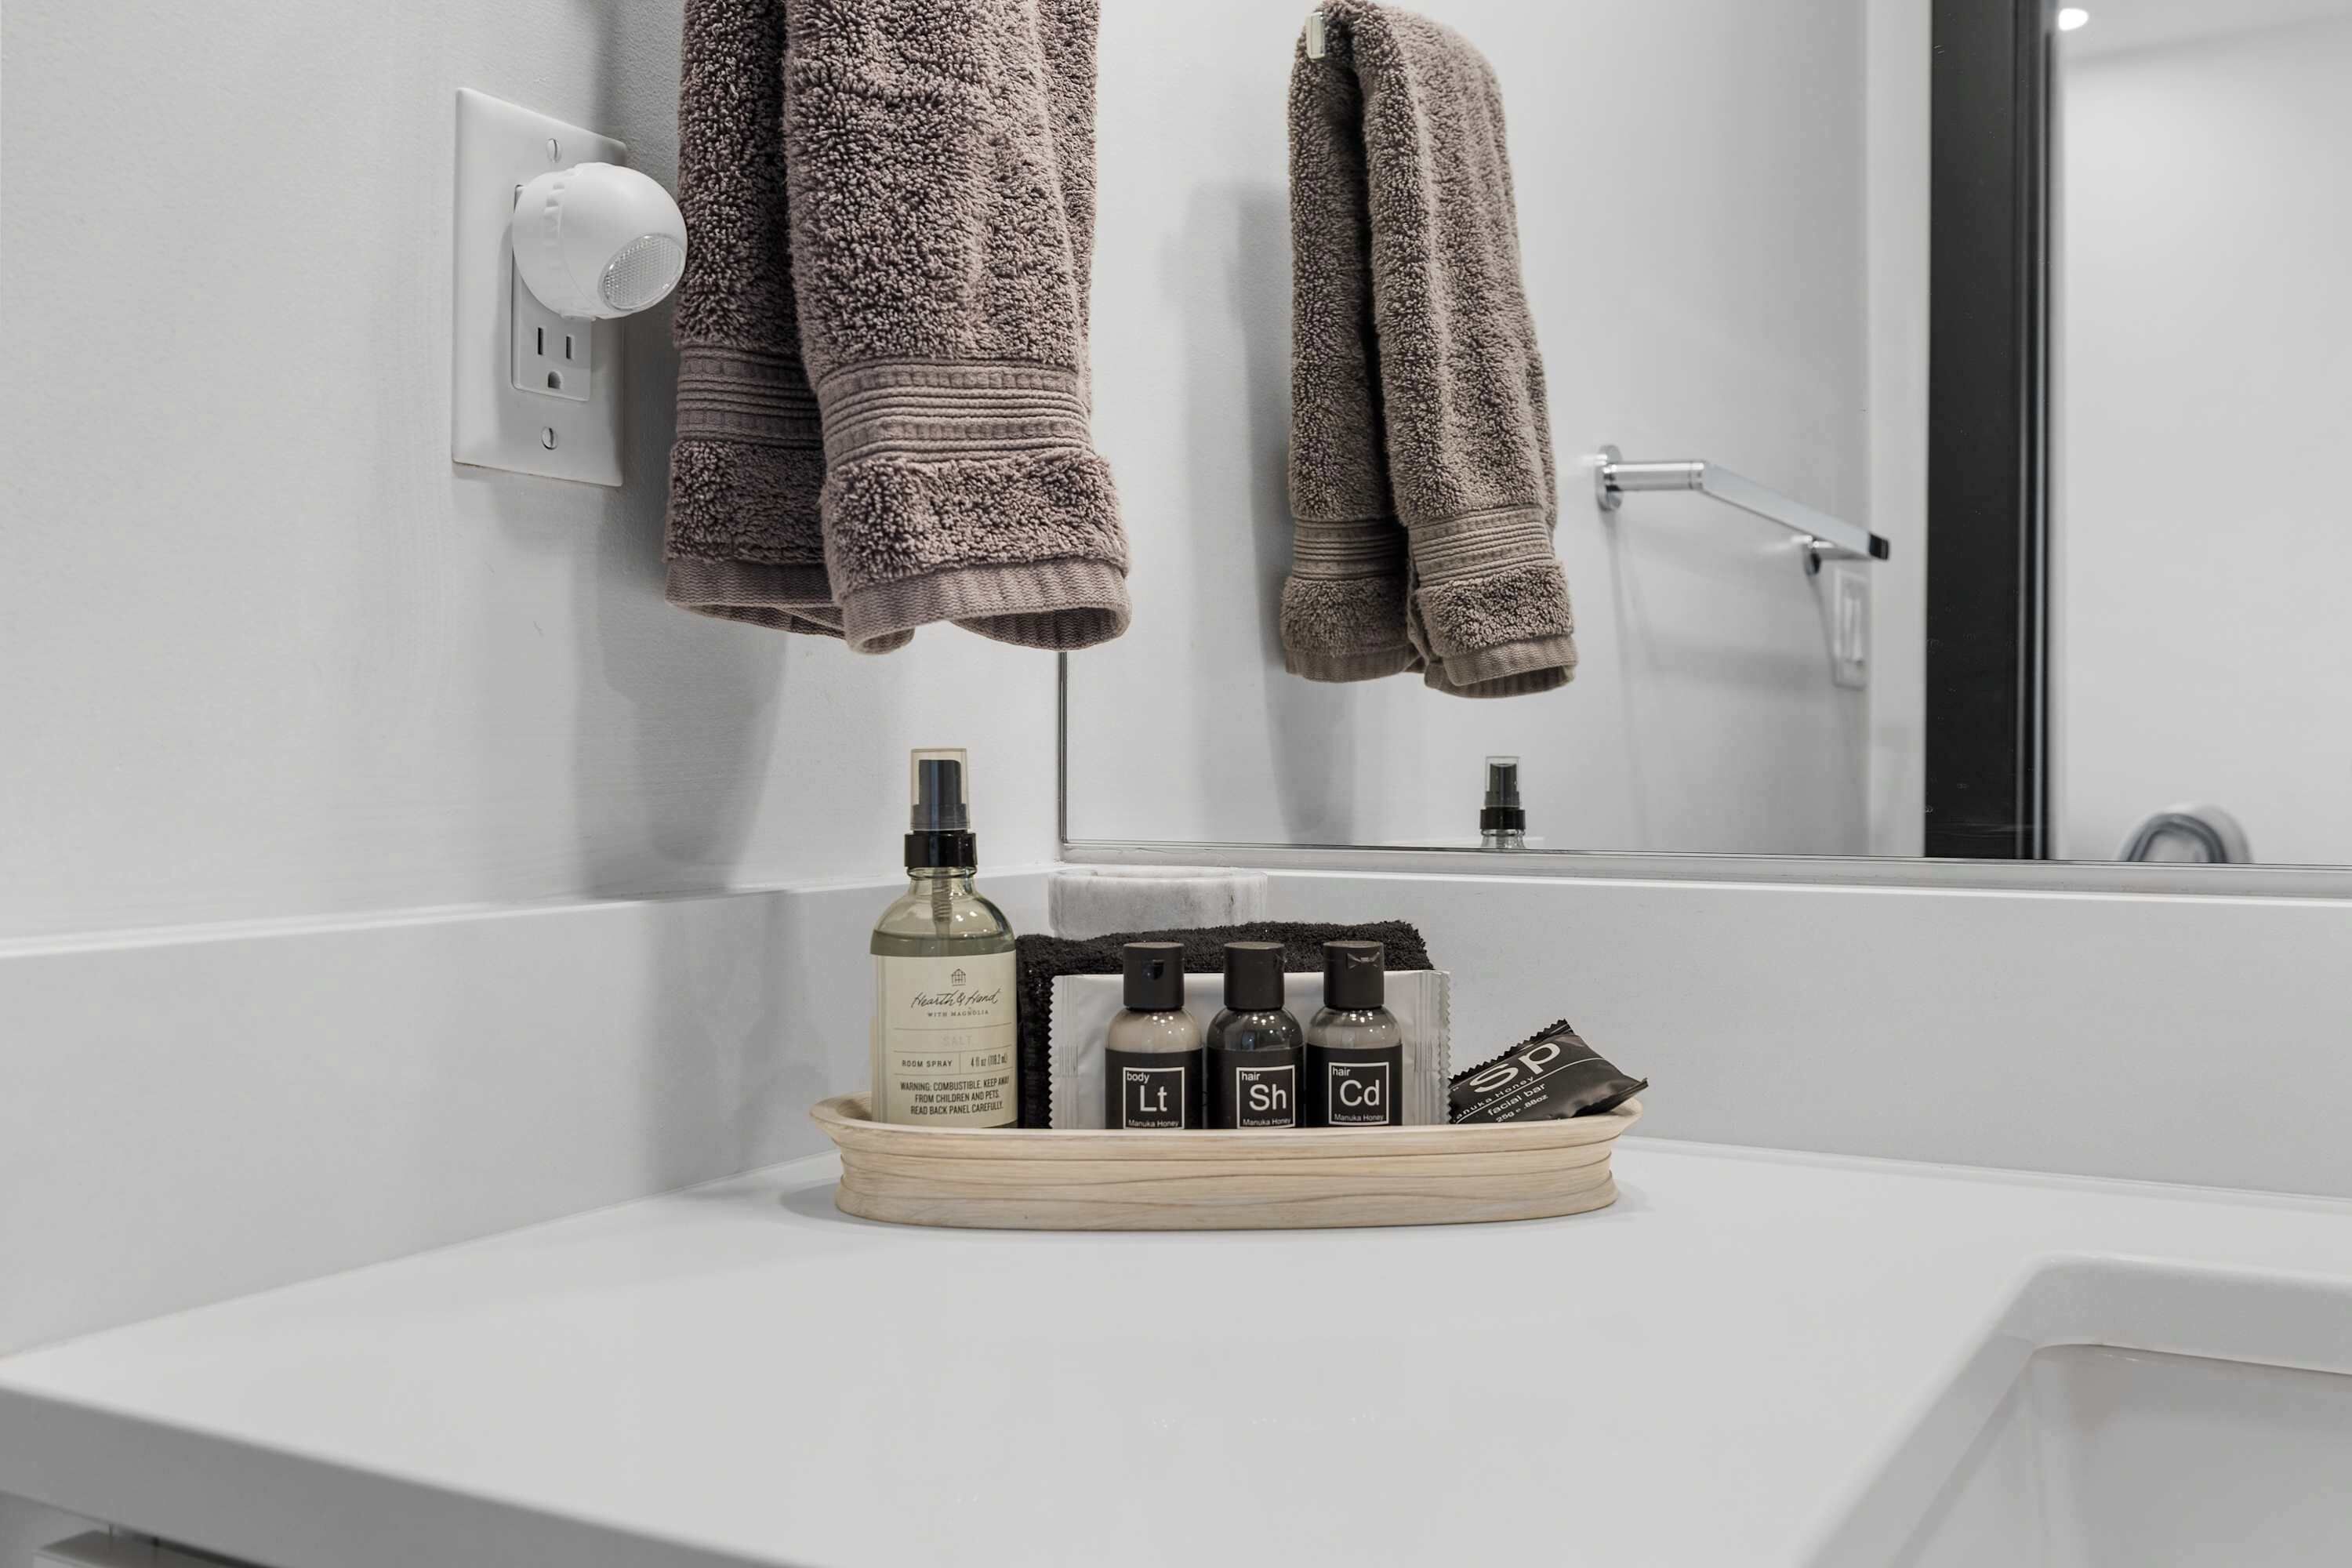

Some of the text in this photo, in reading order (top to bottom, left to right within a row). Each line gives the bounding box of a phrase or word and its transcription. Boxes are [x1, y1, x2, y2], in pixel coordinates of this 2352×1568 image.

[910, 989, 956, 1008] Hearth
[964, 988, 1001, 1006] Hand
[1126, 1071, 1150, 1083] body
[1241, 1071, 1261, 1082] hair
[1333, 1066, 1352, 1077] hair
[900, 1082, 932, 1091] WARNING:
[933, 1080, 982, 1091] COMBUSTIBLE.
[983, 1077, 997, 1088] KEEP
[915, 1094, 935, 1103] FROM
[935, 1092, 971, 1103] CHILDREN
[971, 1091, 985, 1101] AND
[1139, 1085, 1168, 1112] Lt
[1249, 1084, 1287, 1112] Sh
[1339, 1079, 1381, 1107] Cd
[1453, 1076, 1534, 1122] anuka Honey
[1487, 1083, 1546, 1116] facial bar
[910, 1101, 1004, 1115] READ BACK PANEL CAREFULLY.
[1128, 1119, 1180, 1128] Manuka Honey
[1243, 1117, 1292, 1127] Manuka Honey
[1334, 1112, 1385, 1123] Manuka Honey
